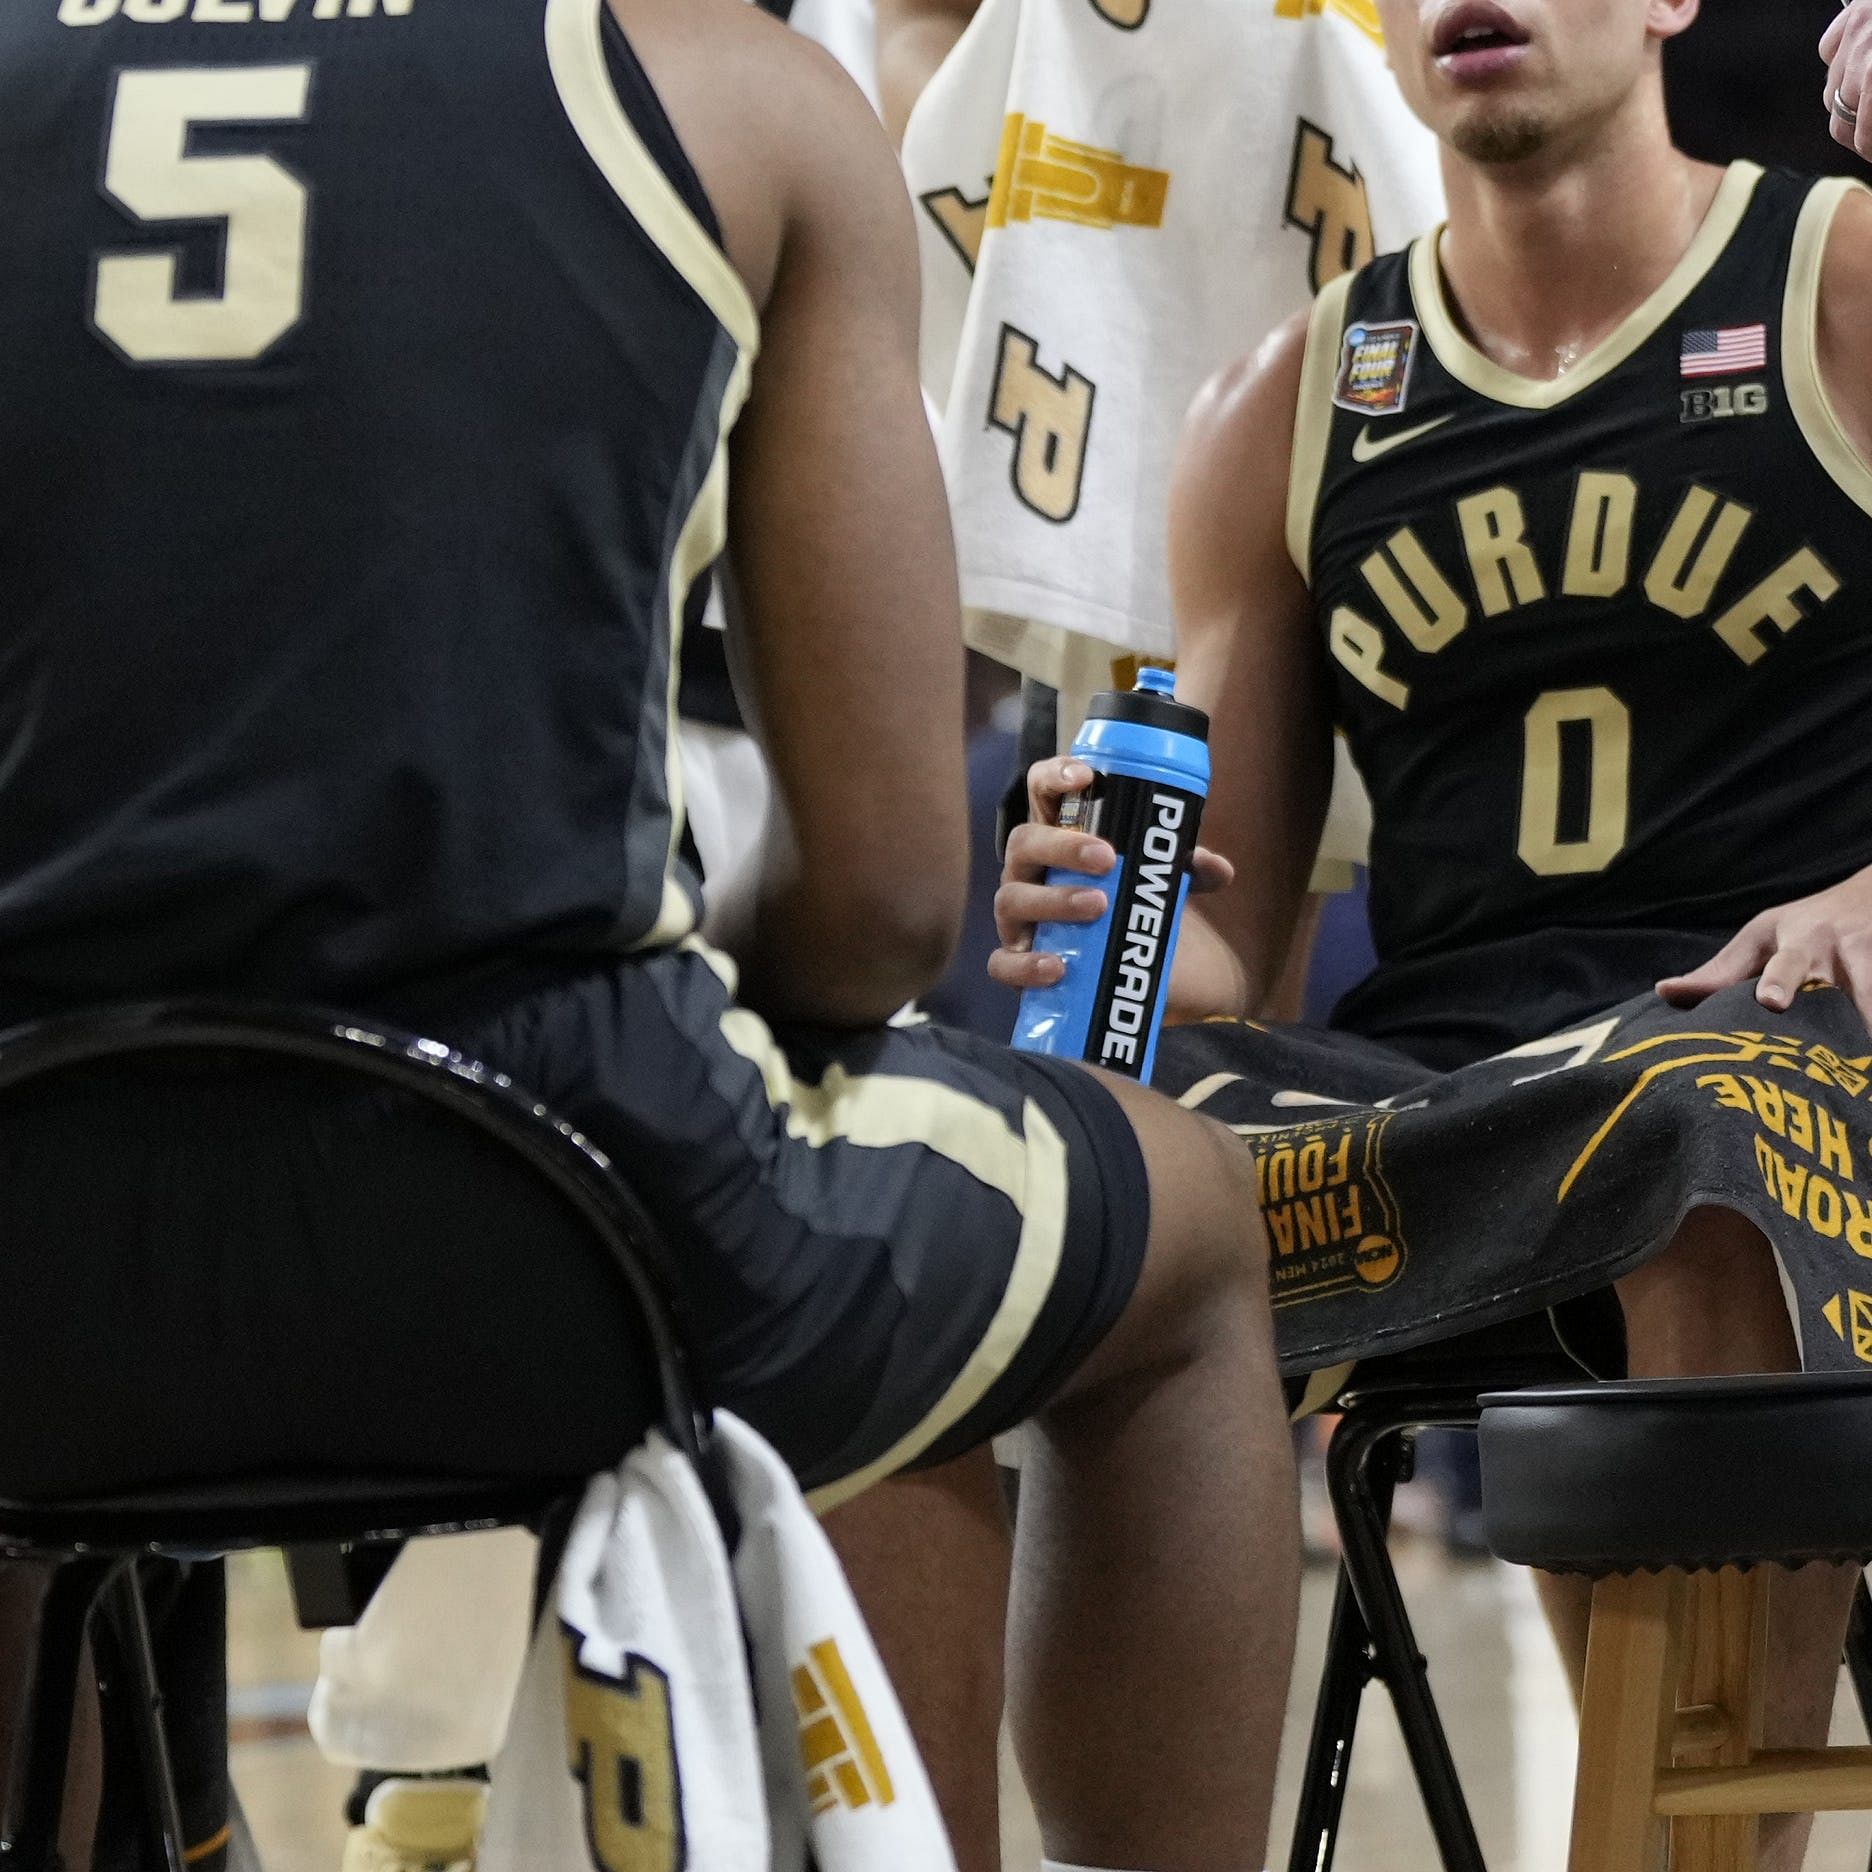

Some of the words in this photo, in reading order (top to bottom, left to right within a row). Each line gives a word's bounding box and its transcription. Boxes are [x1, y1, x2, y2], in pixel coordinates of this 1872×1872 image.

[93, 64, 312, 361] 5
[987, 322, 1096, 524] P
[1329, 471, 1843, 711] PURDUE
[1517, 686, 1630, 876] 0
[1101, 793, 1185, 1065] POWERADE
[1267, 1184, 1362, 1256] FINA
[1695, 1073, 1854, 1182] HERE
[1275, 1263, 1307, 1280] MEN
